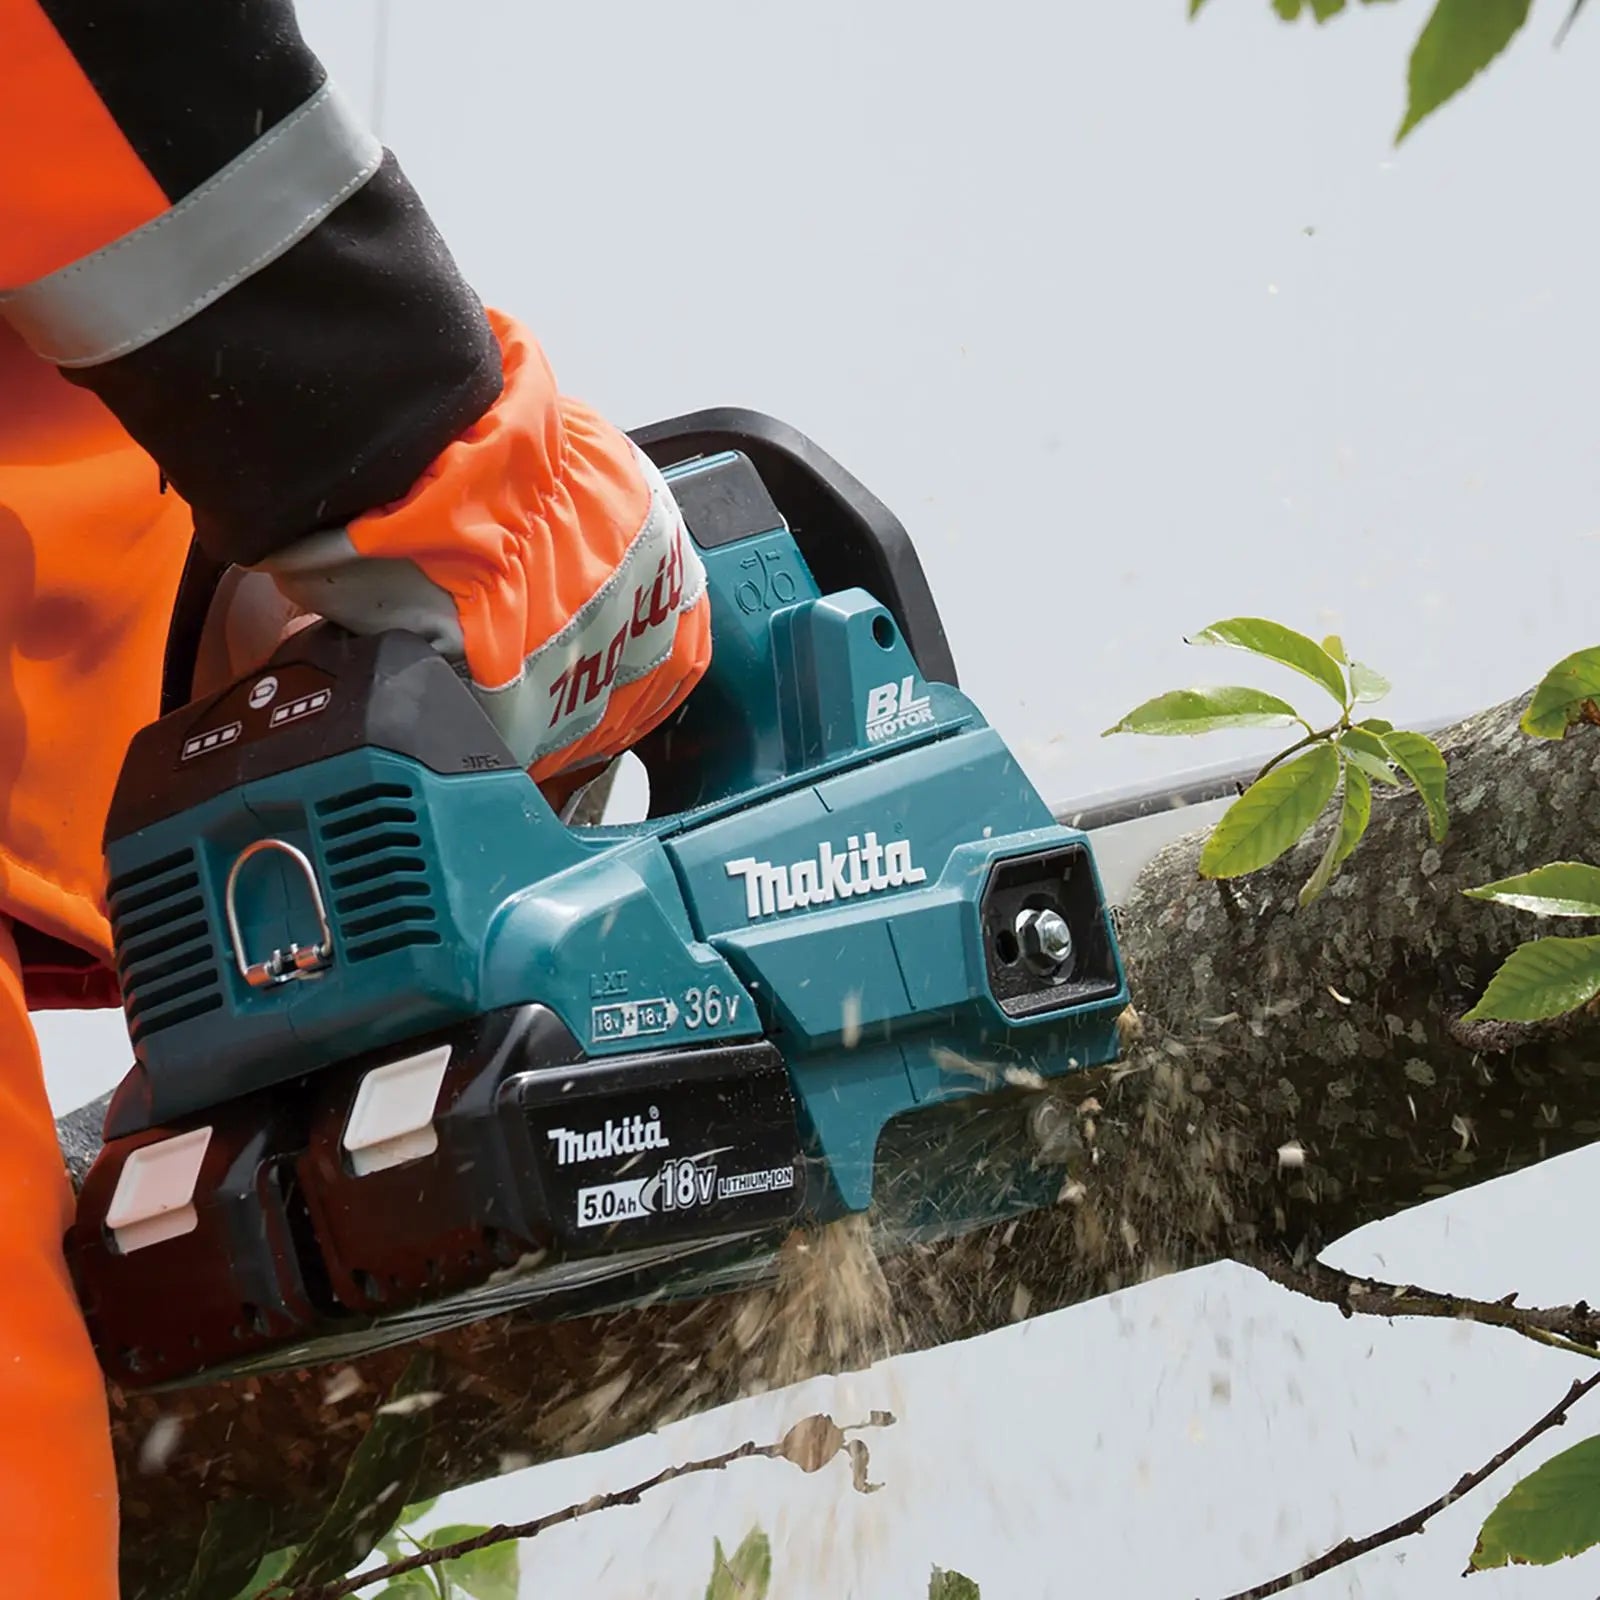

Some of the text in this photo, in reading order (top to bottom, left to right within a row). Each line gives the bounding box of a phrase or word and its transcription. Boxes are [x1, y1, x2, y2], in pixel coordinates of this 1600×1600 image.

[866, 674, 931, 724] BL
[865, 708, 935, 742] MOTOR
[718, 1167, 793, 1199] LITHIUM-ION
